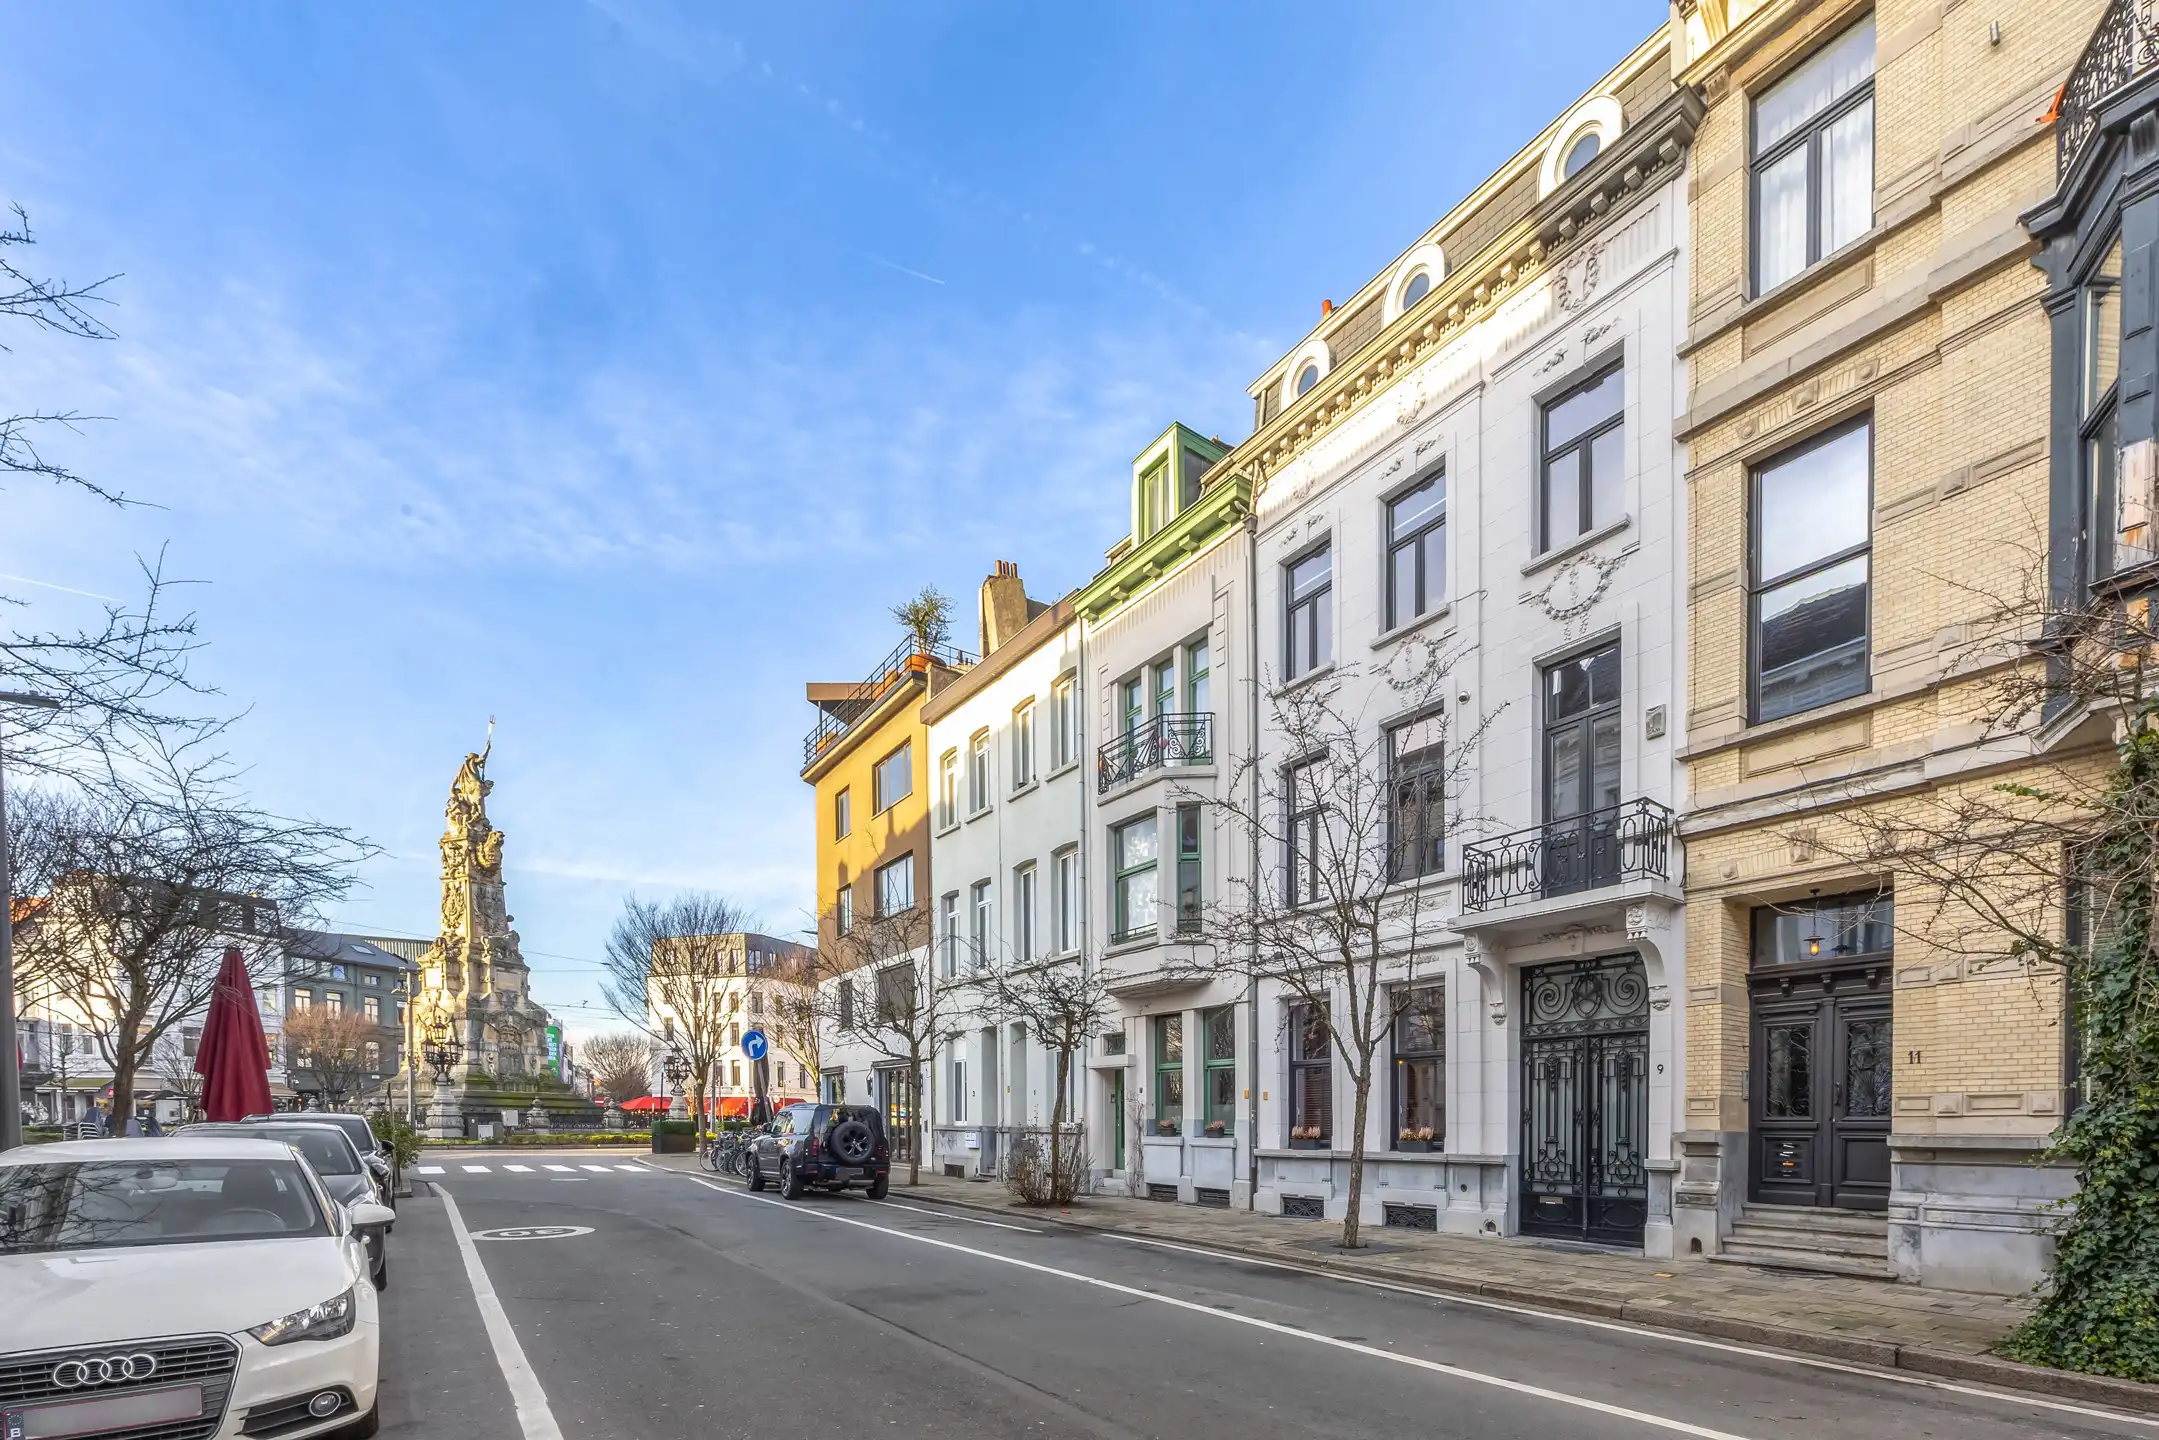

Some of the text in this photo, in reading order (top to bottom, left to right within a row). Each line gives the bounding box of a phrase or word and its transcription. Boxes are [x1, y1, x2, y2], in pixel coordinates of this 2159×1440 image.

[1908, 1050, 1921, 1064] 11
[1657, 1064, 1664, 1074] 9
[10, 1428, 21, 1437] B
